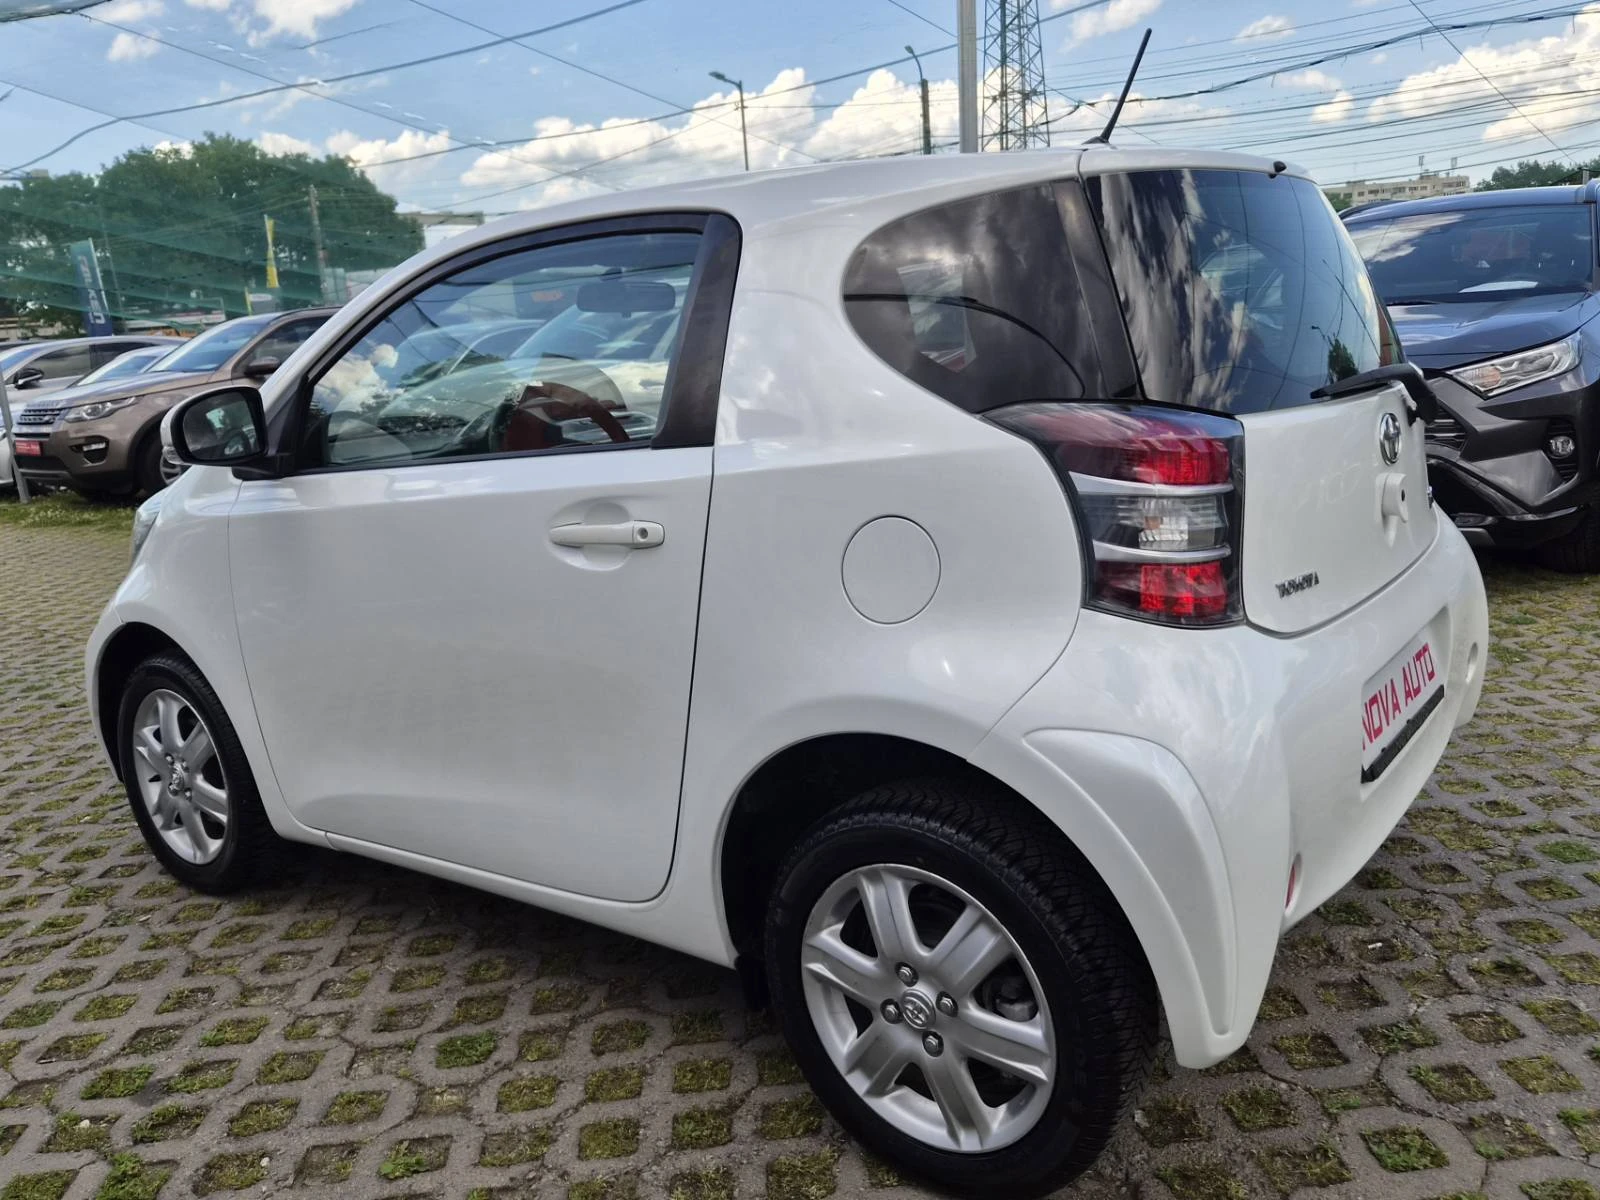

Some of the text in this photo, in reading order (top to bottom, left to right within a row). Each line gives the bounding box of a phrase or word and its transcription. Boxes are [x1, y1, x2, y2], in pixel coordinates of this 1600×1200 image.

[1275, 571, 1319, 599] TOYOTA
[1362, 643, 1435, 751] NOVA AUTO
